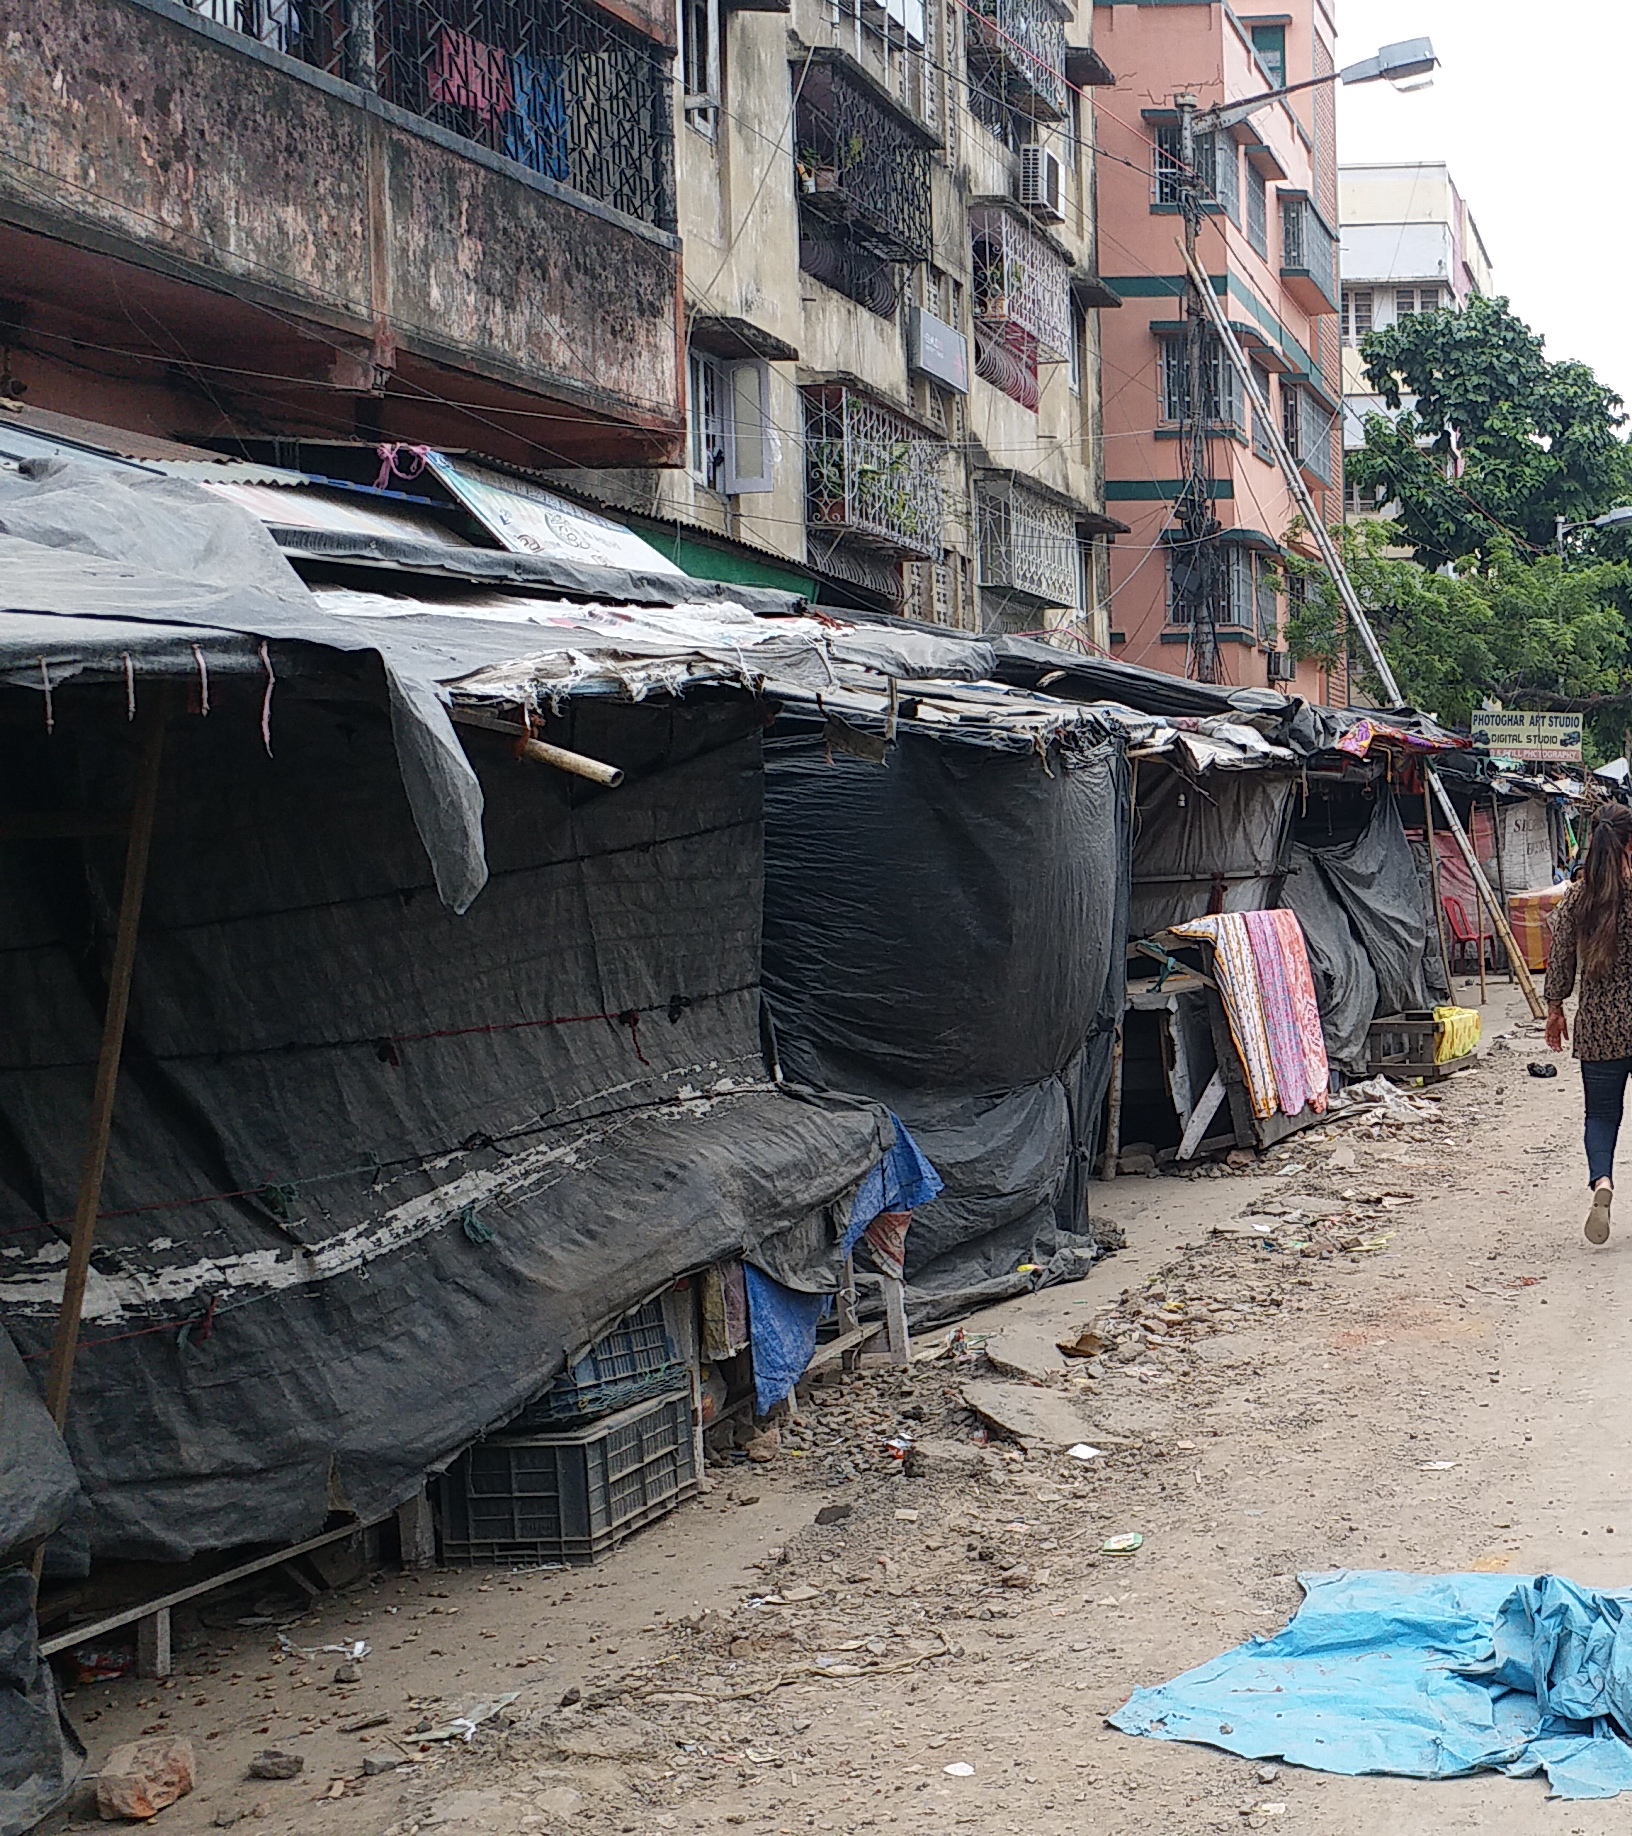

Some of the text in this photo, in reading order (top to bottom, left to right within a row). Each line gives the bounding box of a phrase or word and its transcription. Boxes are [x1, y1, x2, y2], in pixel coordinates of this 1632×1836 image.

[1472, 714, 1580, 728] PHOTOGHAR ART STUDIO
[1491, 733, 1558, 745] DIGITAL STUDIO
[1523, 749, 1577, 759] PHOTOGRAPHY
